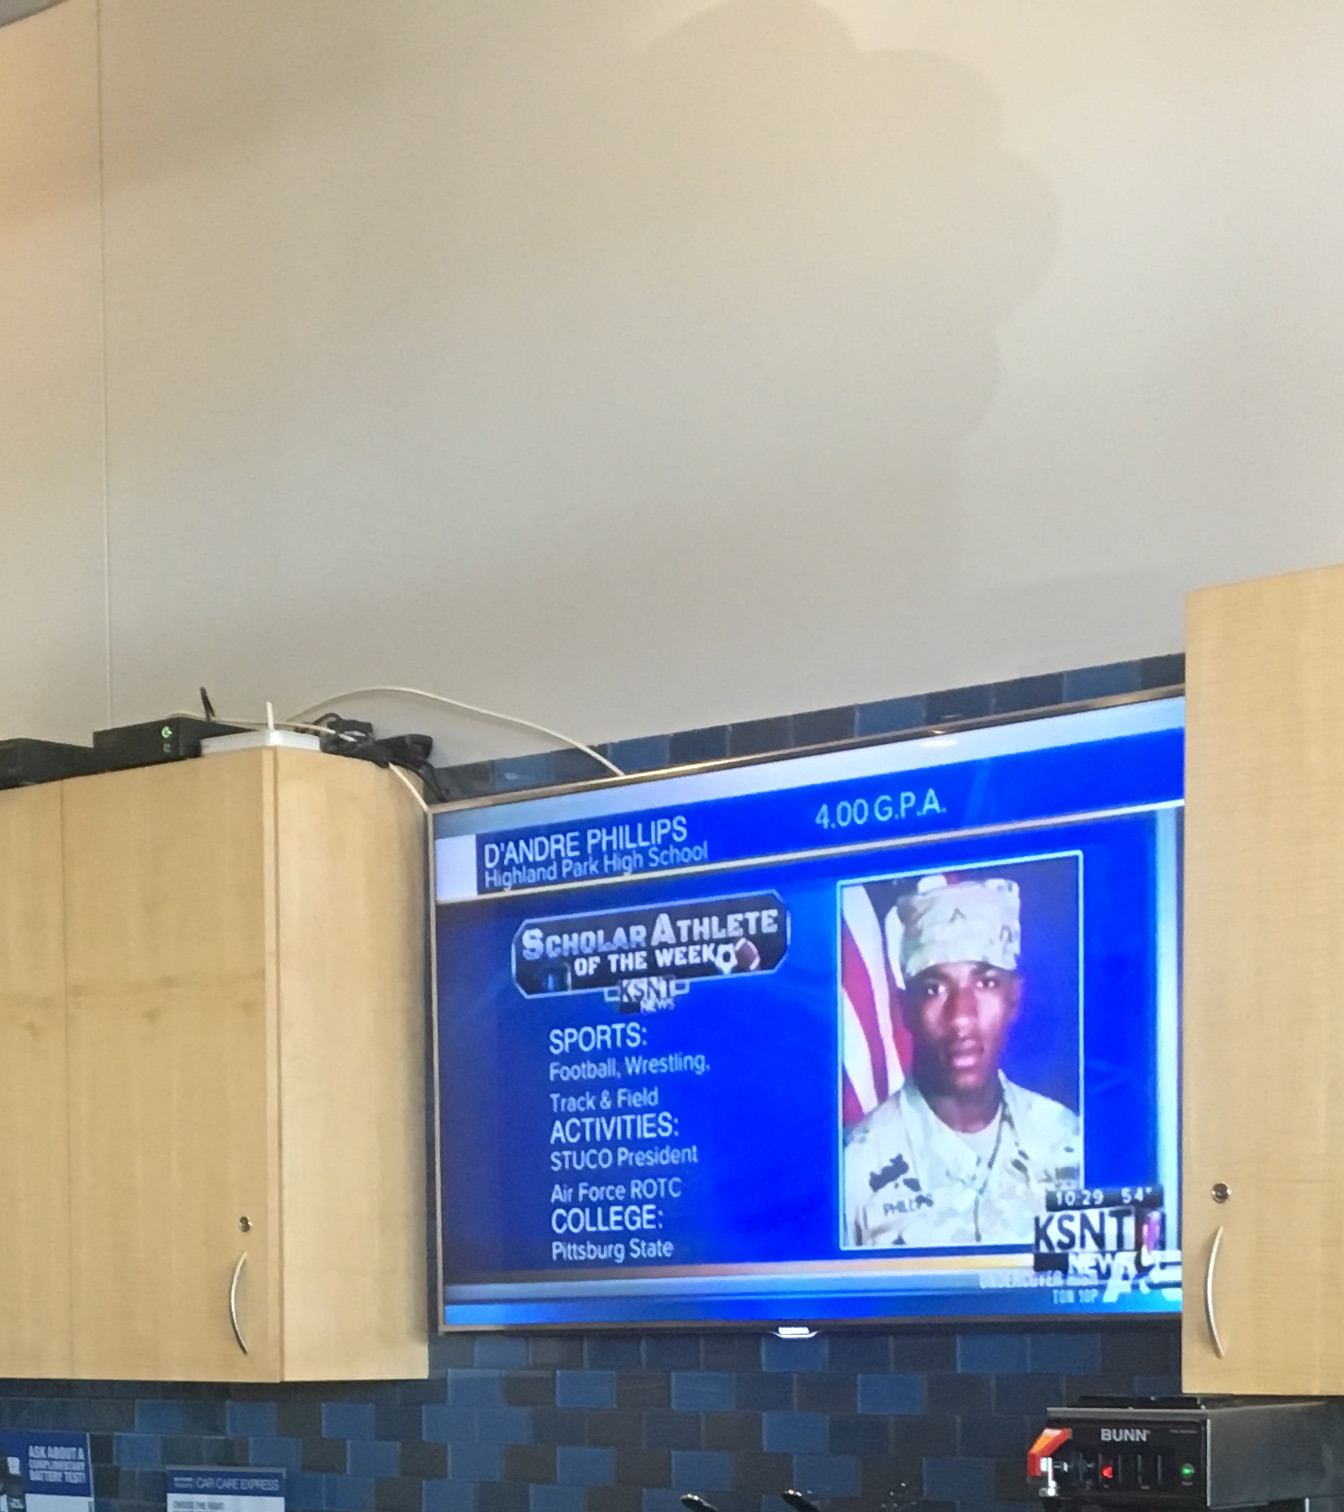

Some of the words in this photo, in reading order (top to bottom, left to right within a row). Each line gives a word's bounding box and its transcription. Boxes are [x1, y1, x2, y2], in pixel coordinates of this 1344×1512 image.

[815, 798, 868, 829] 4.00
[874, 787, 947, 821] G.P.A.
[484, 831, 580, 868] D'ANDRE
[587, 815, 688, 853] PHILLIPS
[484, 865, 557, 891] Highland
[562, 856, 599, 878] Park
[604, 851, 643, 878] High
[648, 841, 708, 868] School
[574, 955, 601, 976] OF
[608, 951, 648, 974] THE
[655, 943, 716, 968] WEEK
[620, 974, 677, 1003] KSNT
[639, 998, 676, 1014] NEWS
[549, 1022, 648, 1055] SPORTS:
[549, 1058, 622, 1082] Football,
[624, 1052, 710, 1076] Wrestling,
[550, 1091, 596, 1113] Track
[600, 1089, 612, 1110] &
[617, 1086, 660, 1108] Field
[550, 1111, 679, 1145] ACTIVITIES:
[550, 1148, 613, 1172] STUCO
[617, 1144, 698, 1167] President
[550, 1183, 574, 1204] Air
[578, 1181, 627, 1202] Force
[630, 1177, 683, 1199] ROTC
[550, 1203, 664, 1234] COLLEGE:
[1034, 1208, 1133, 1253] KSNT
[551, 1240, 626, 1264] Pittsburg
[629, 1238, 675, 1258] State
[1100, 1428, 1148, 1442] BUNN
[28, 1445, 47, 1459] ASK
[48, 1445, 77, 1460] ABOUT
[196, 1477, 214, 1490] CAR
[216, 1477, 238, 1490] CARE
[240, 1478, 279, 1491] EXPRESS
